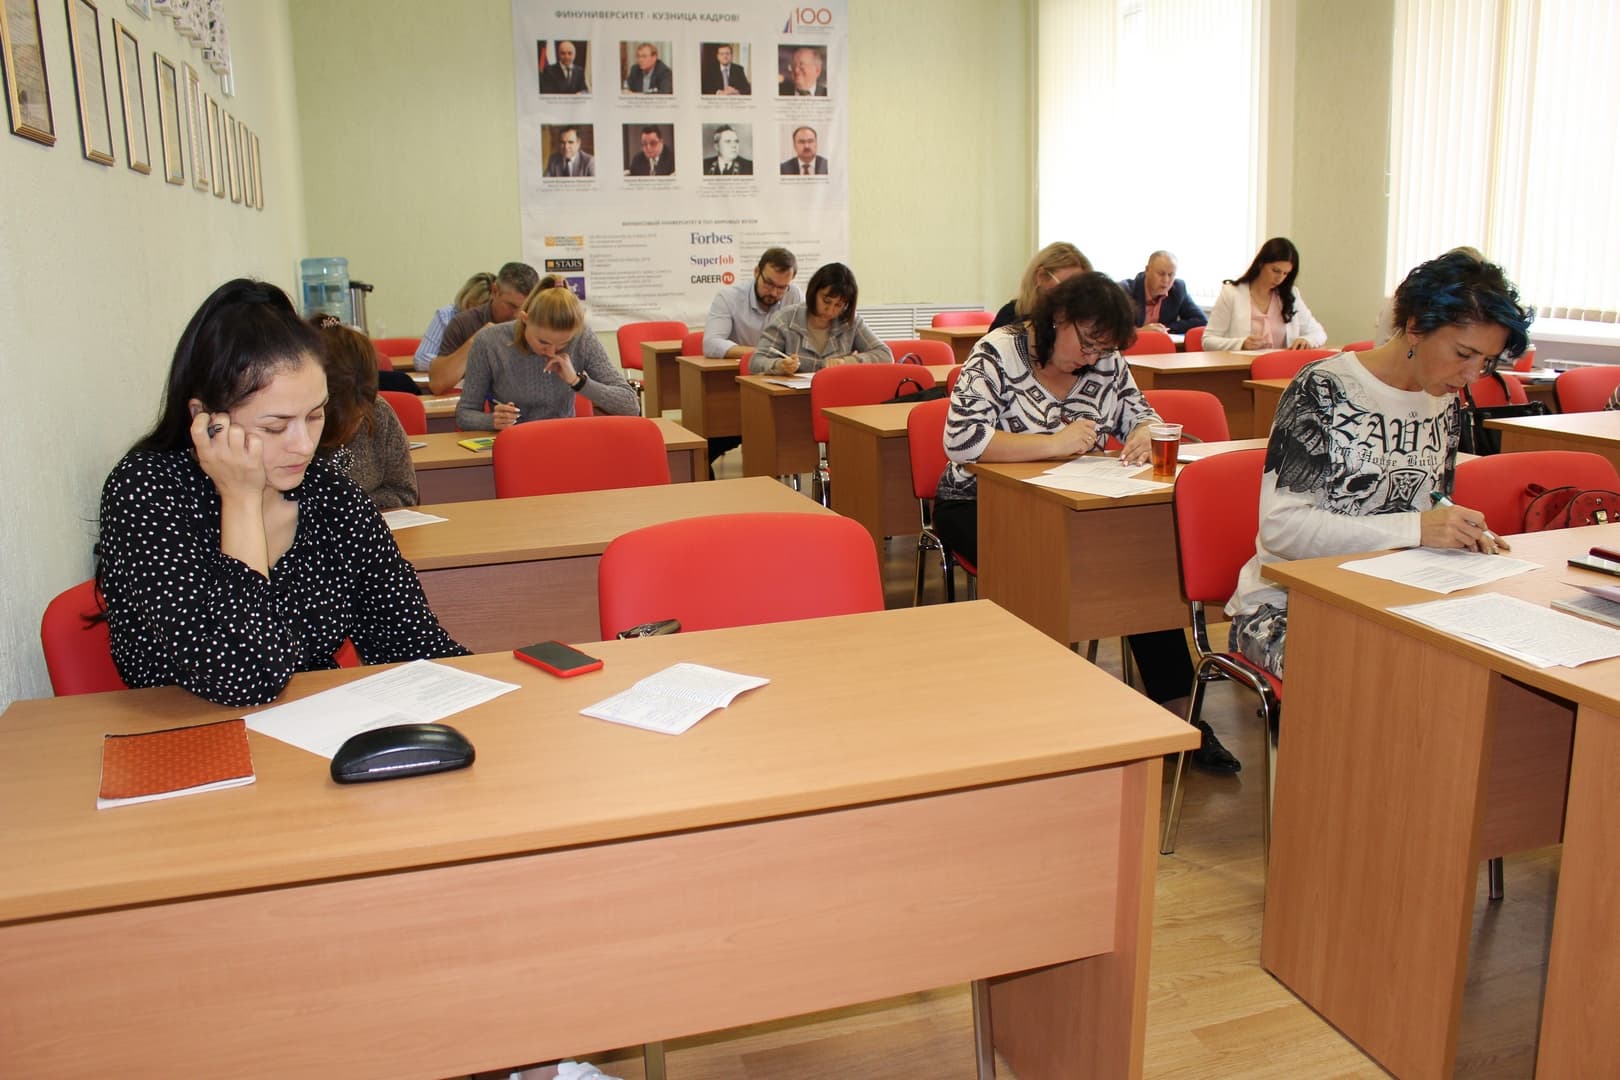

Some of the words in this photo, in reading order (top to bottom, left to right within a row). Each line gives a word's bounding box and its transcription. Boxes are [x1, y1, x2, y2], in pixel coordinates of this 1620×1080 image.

[554, 9, 644, 20] ФИНУНИВЕРСИТЕТ
[652, 11, 698, 23] КУЗНИЦА
[796, 7, 832, 24] 100
[690, 231, 733, 245] Forbes
[555, 260, 583, 268] STARS
[690, 274, 721, 284] CAREER
